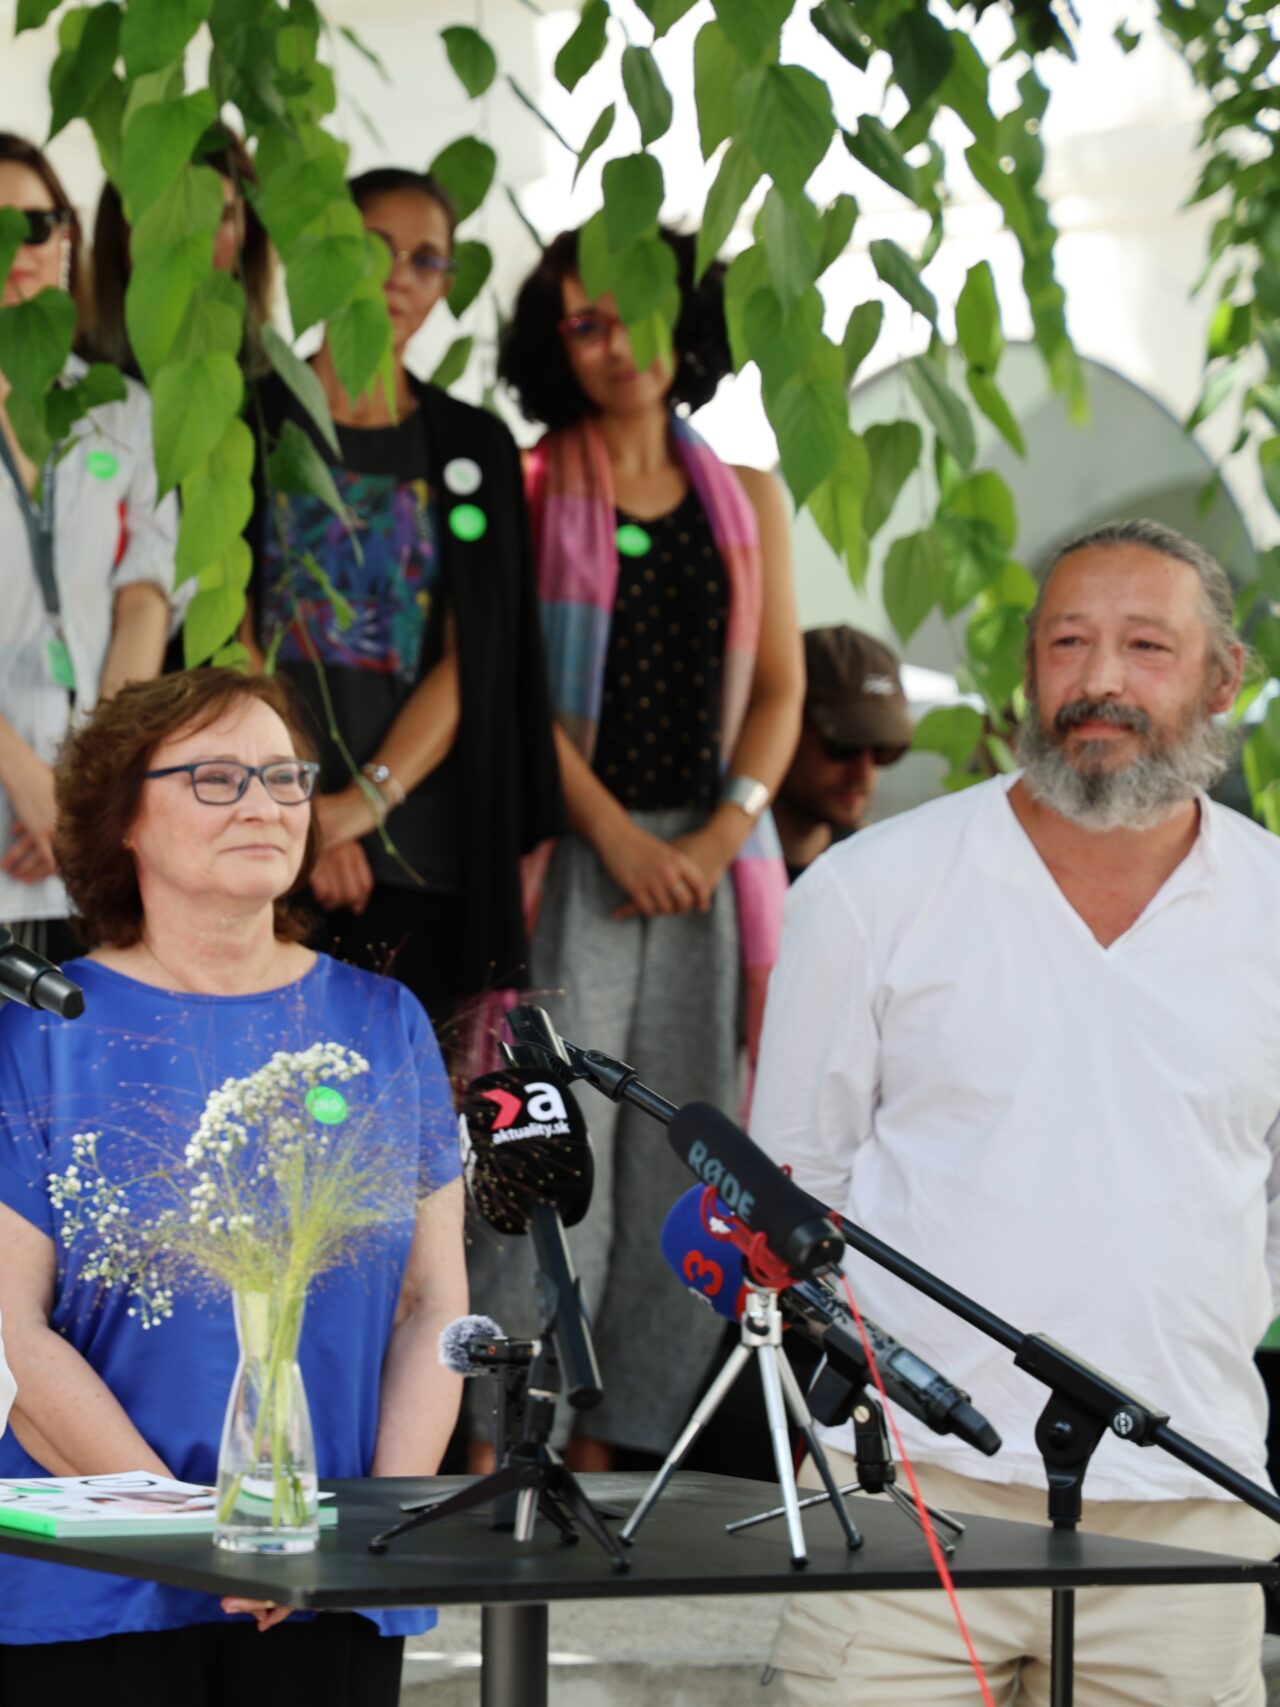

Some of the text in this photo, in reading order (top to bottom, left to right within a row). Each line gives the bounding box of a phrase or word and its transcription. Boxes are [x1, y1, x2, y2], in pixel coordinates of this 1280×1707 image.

[523, 1081, 568, 1122] a
[492, 1119, 571, 1146] aktuality.sk
[688, 1138, 755, 1224] RØDE
[683, 1249, 723, 1297] 3
